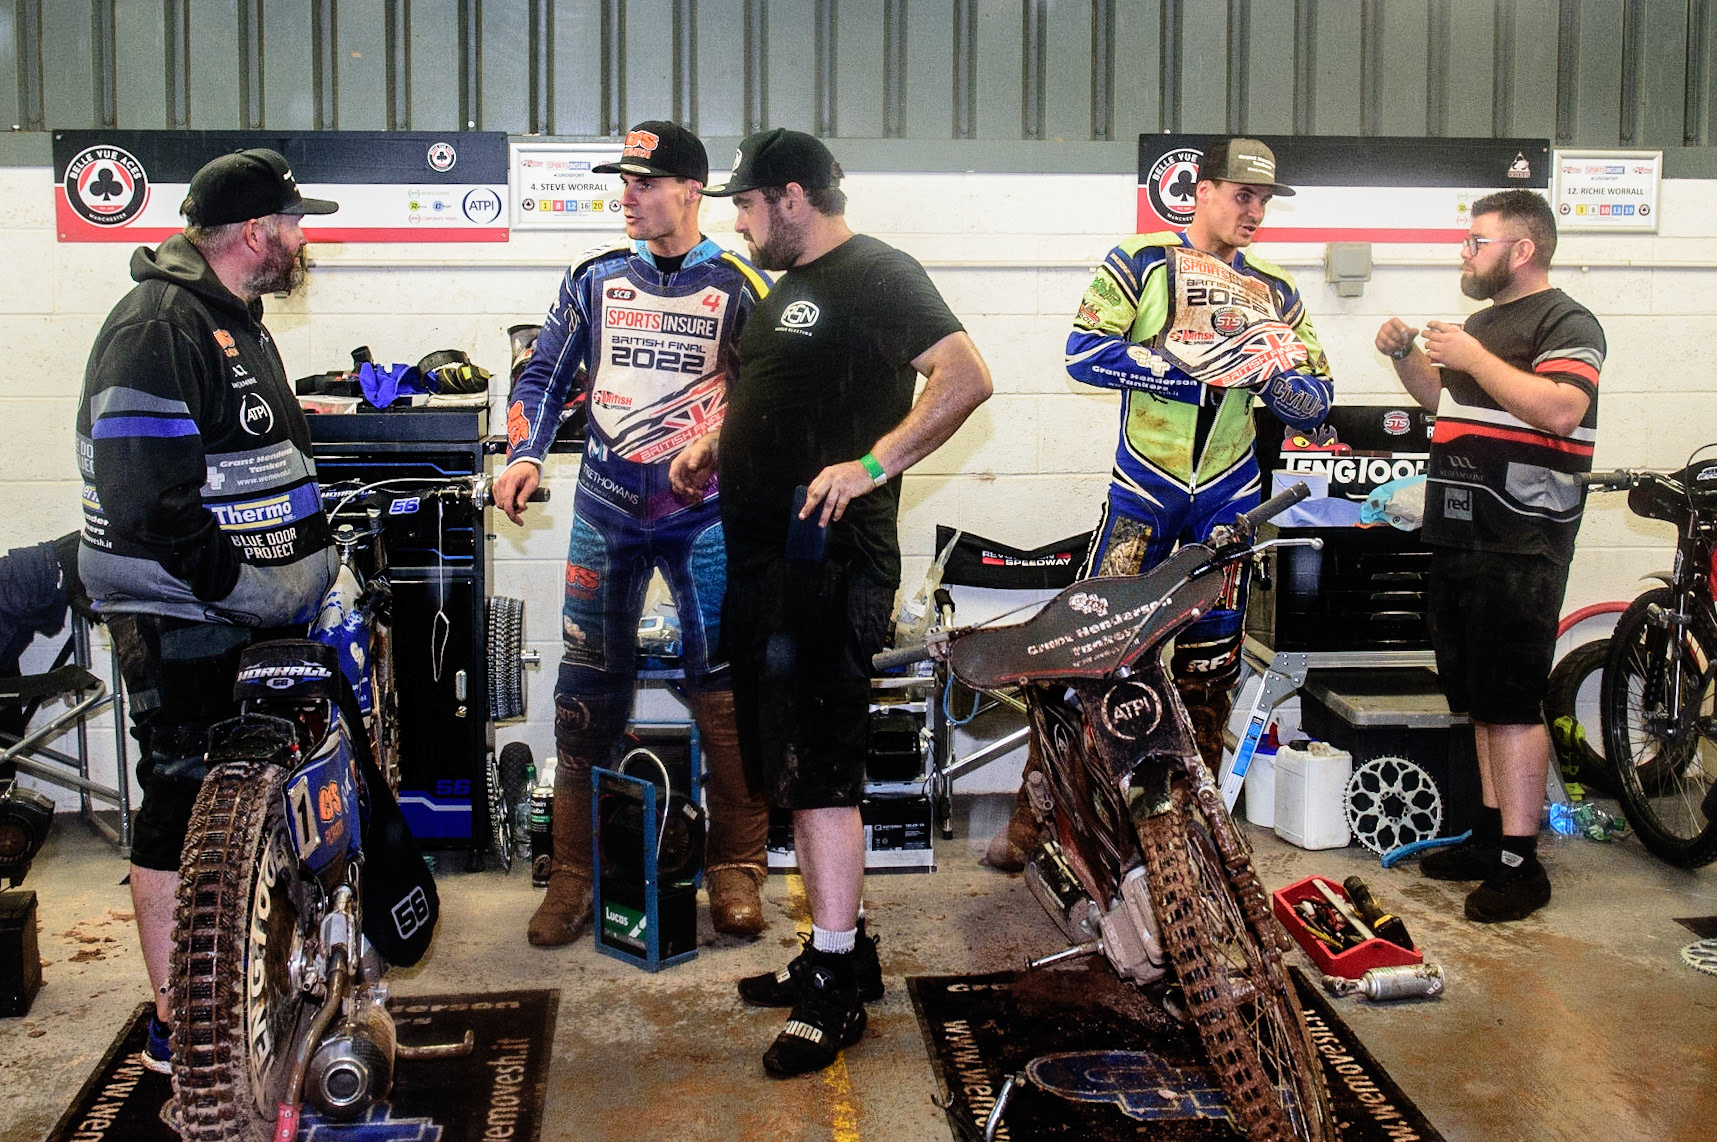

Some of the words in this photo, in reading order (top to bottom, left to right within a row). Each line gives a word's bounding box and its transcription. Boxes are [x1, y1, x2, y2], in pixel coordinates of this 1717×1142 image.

[70, 152, 93, 180] BELLE
[96, 150, 118, 160] VUE
[119, 156, 143, 180] ACES
[1152, 156, 1175, 182] BELLE
[1177, 153, 1198, 163] VUE
[530, 183, 538, 191] 4.
[541, 183, 565, 191] STEVE
[568, 183, 608, 191] WORRALL
[468, 200, 495, 212] ATPI
[88, 212, 127, 223] MANCHESTER
[612, 289, 632, 299] SCB
[702, 294, 721, 313] 4
[608, 309, 661, 330] SPORTS
[662, 317, 715, 338] INSURE
[1217, 316, 1241, 325] STS
[611, 335, 665, 348] BRITISH
[668, 341, 706, 354] FINAL
[611, 346, 706, 375] 2022
[1222, 353, 1269, 385] BRITISH
[1091, 365, 1127, 378] Grant
[1130, 373, 1198, 386] Henderson
[1119, 378, 1169, 391] Tankers
[247, 404, 268, 422] ATPI
[1386, 418, 1407, 427] STS
[640, 430, 694, 461] BRITISH
[220, 458, 255, 468] Grant
[389, 497, 420, 515] 56
[1447, 490, 1470, 512] red
[211, 502, 292, 525] Thermo
[231, 534, 265, 547] BLUE
[266, 527, 297, 546] DOOR
[244, 542, 294, 560] PROJECT
[1005, 559, 1071, 567] SPEEDWAY
[1113, 696, 1151, 723] ATPI
[436, 779, 472, 795] 56
[391, 885, 429, 940] 56
[605, 906, 629, 927] Lucas
[786, 1020, 823, 1044] UMA
[482, 1037, 531, 1142] emovesh.it
